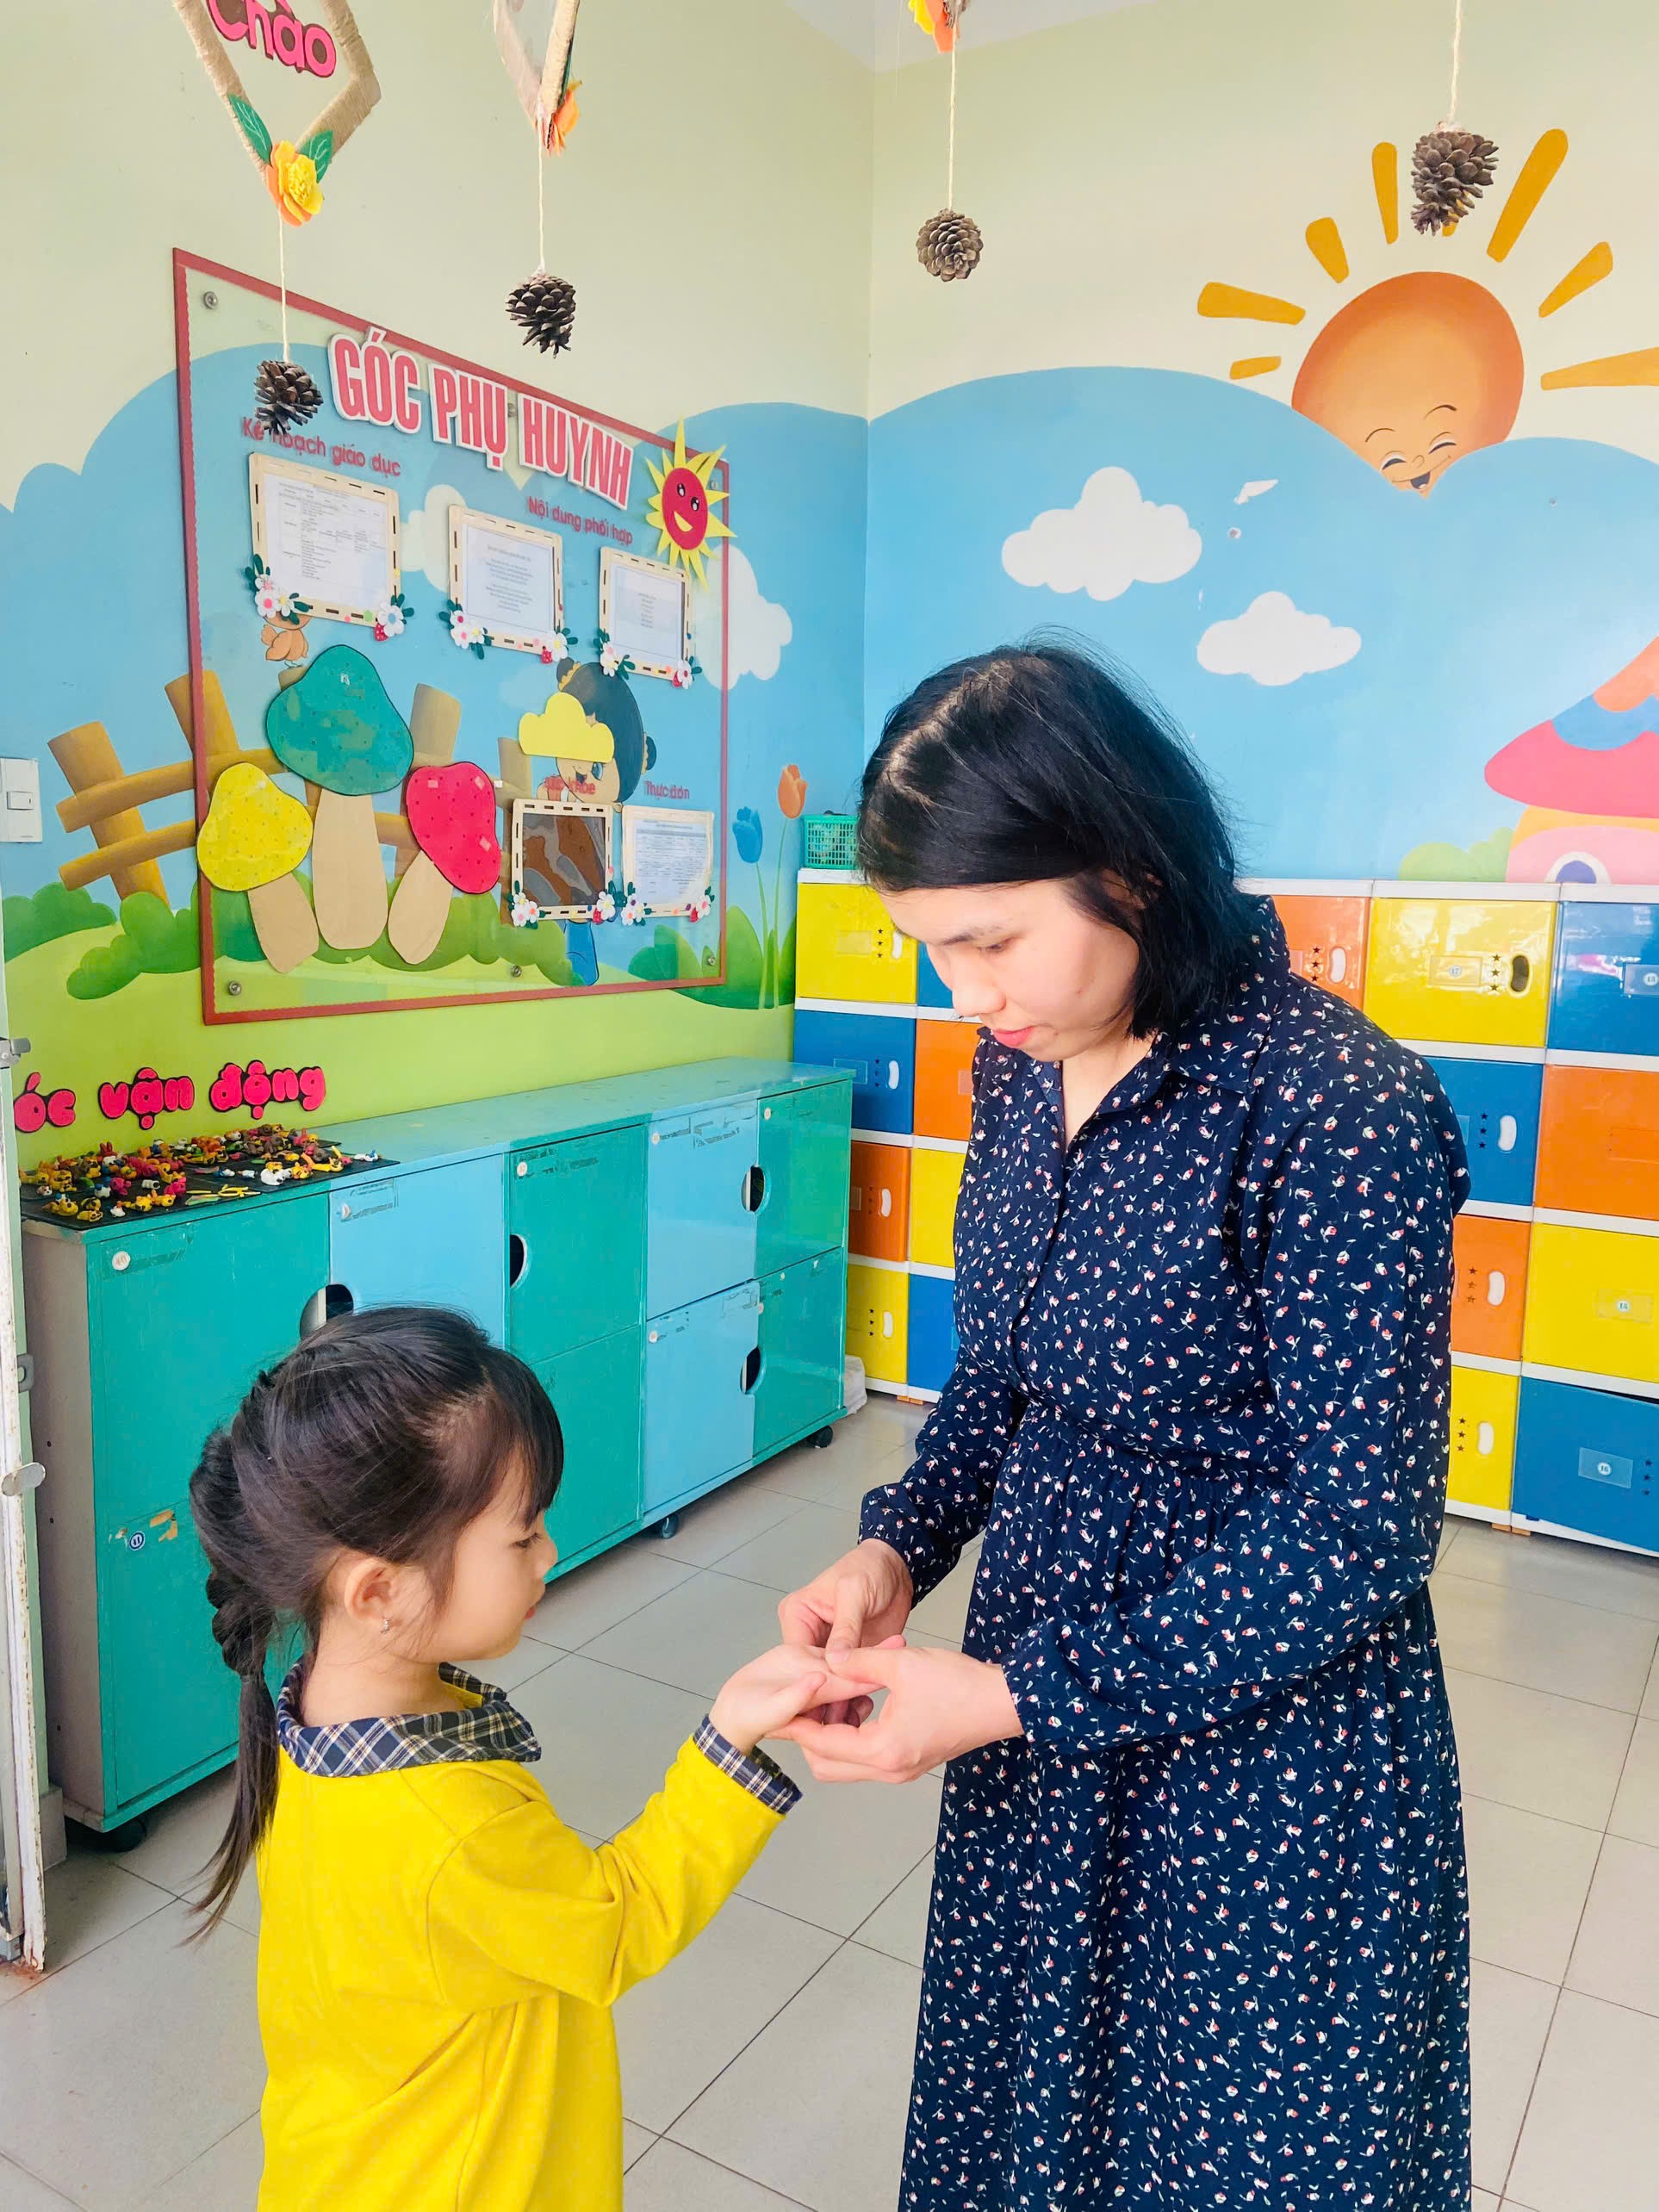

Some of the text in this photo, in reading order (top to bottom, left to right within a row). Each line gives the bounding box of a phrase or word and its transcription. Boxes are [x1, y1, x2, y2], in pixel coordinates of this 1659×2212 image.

[328, 328, 634, 511] GÓC PHỤ HUYNH
[332, 444, 366, 467] giáo
[372, 453, 401, 479] dục
[528, 495, 549, 521] Nội
[552, 506, 581, 532] dung
[585, 517, 610, 537] phối
[14, 1059, 326, 1133] óc vận động
